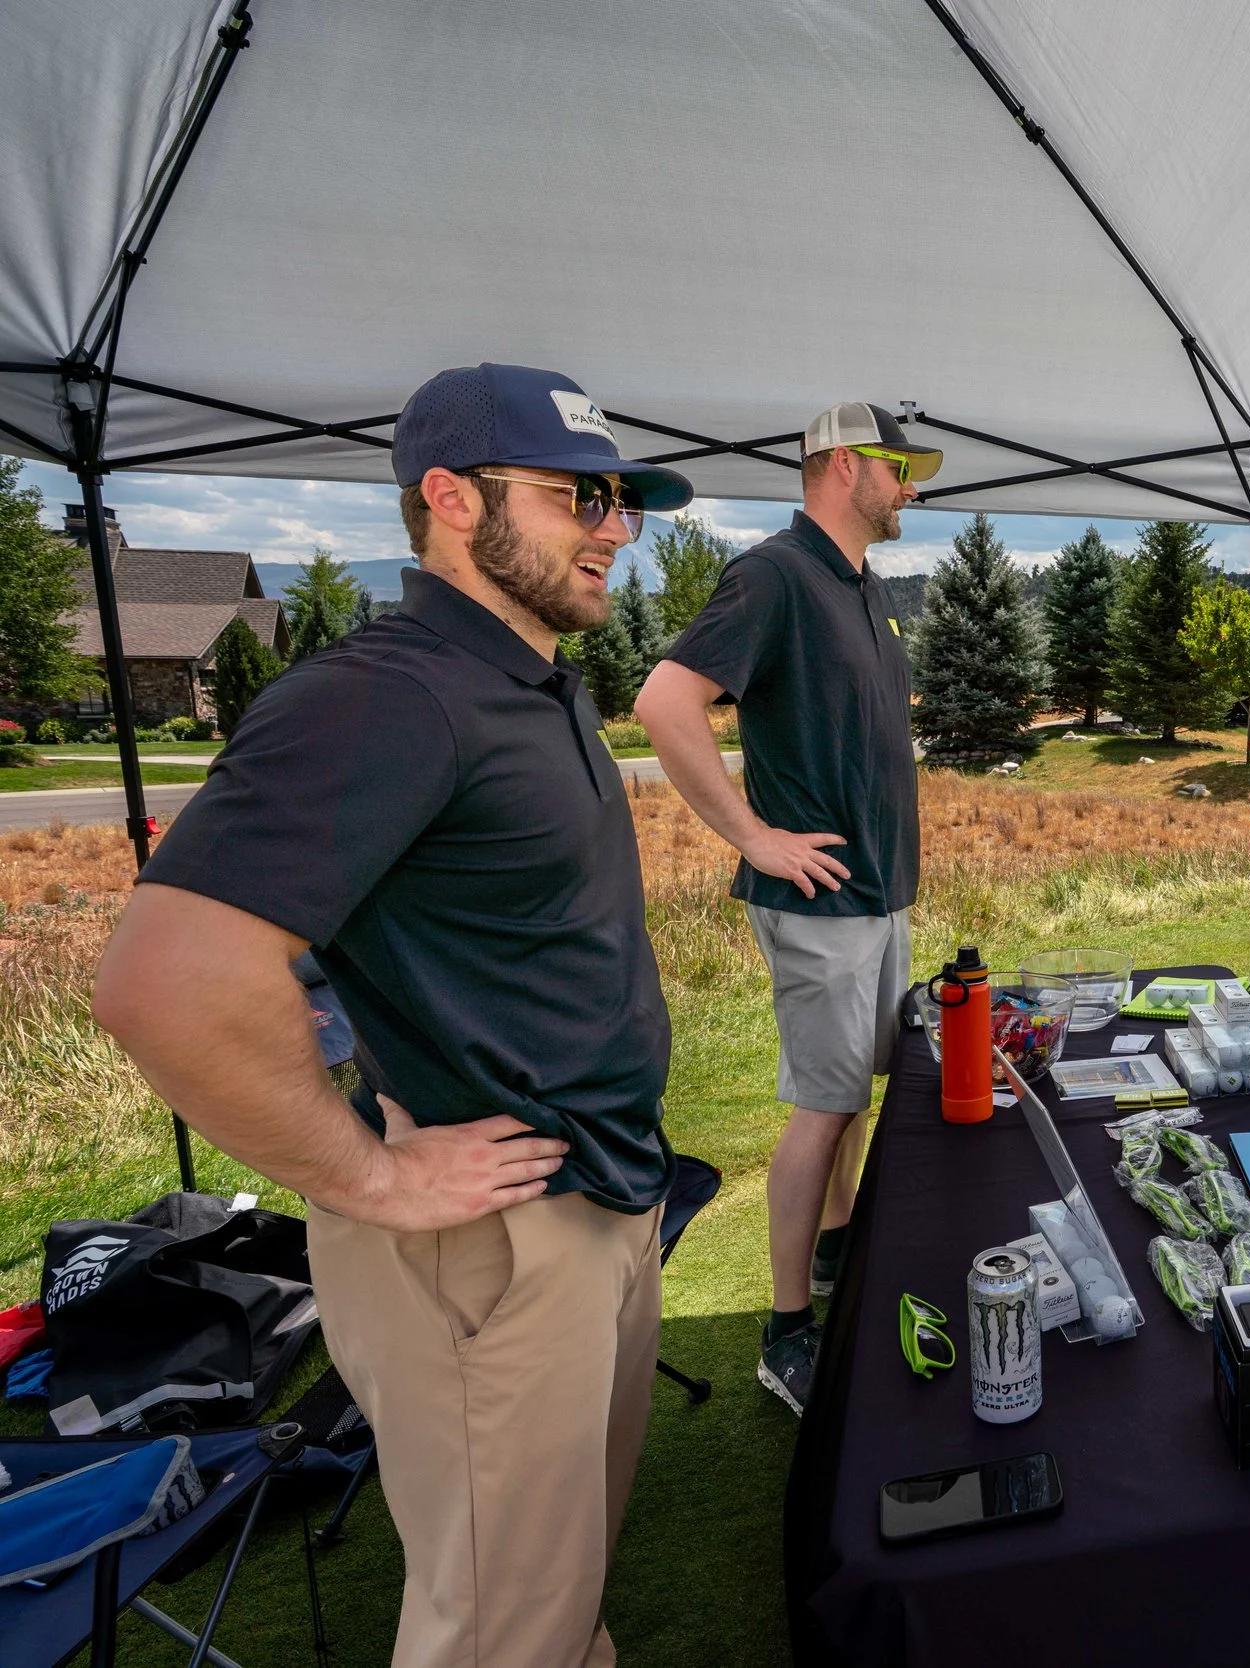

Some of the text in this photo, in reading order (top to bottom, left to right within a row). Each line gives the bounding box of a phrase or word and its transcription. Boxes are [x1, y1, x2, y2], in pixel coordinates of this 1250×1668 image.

[975, 1271, 1028, 1285] ZERO SUGAR
[972, 1372, 1038, 1396] MONSTER
